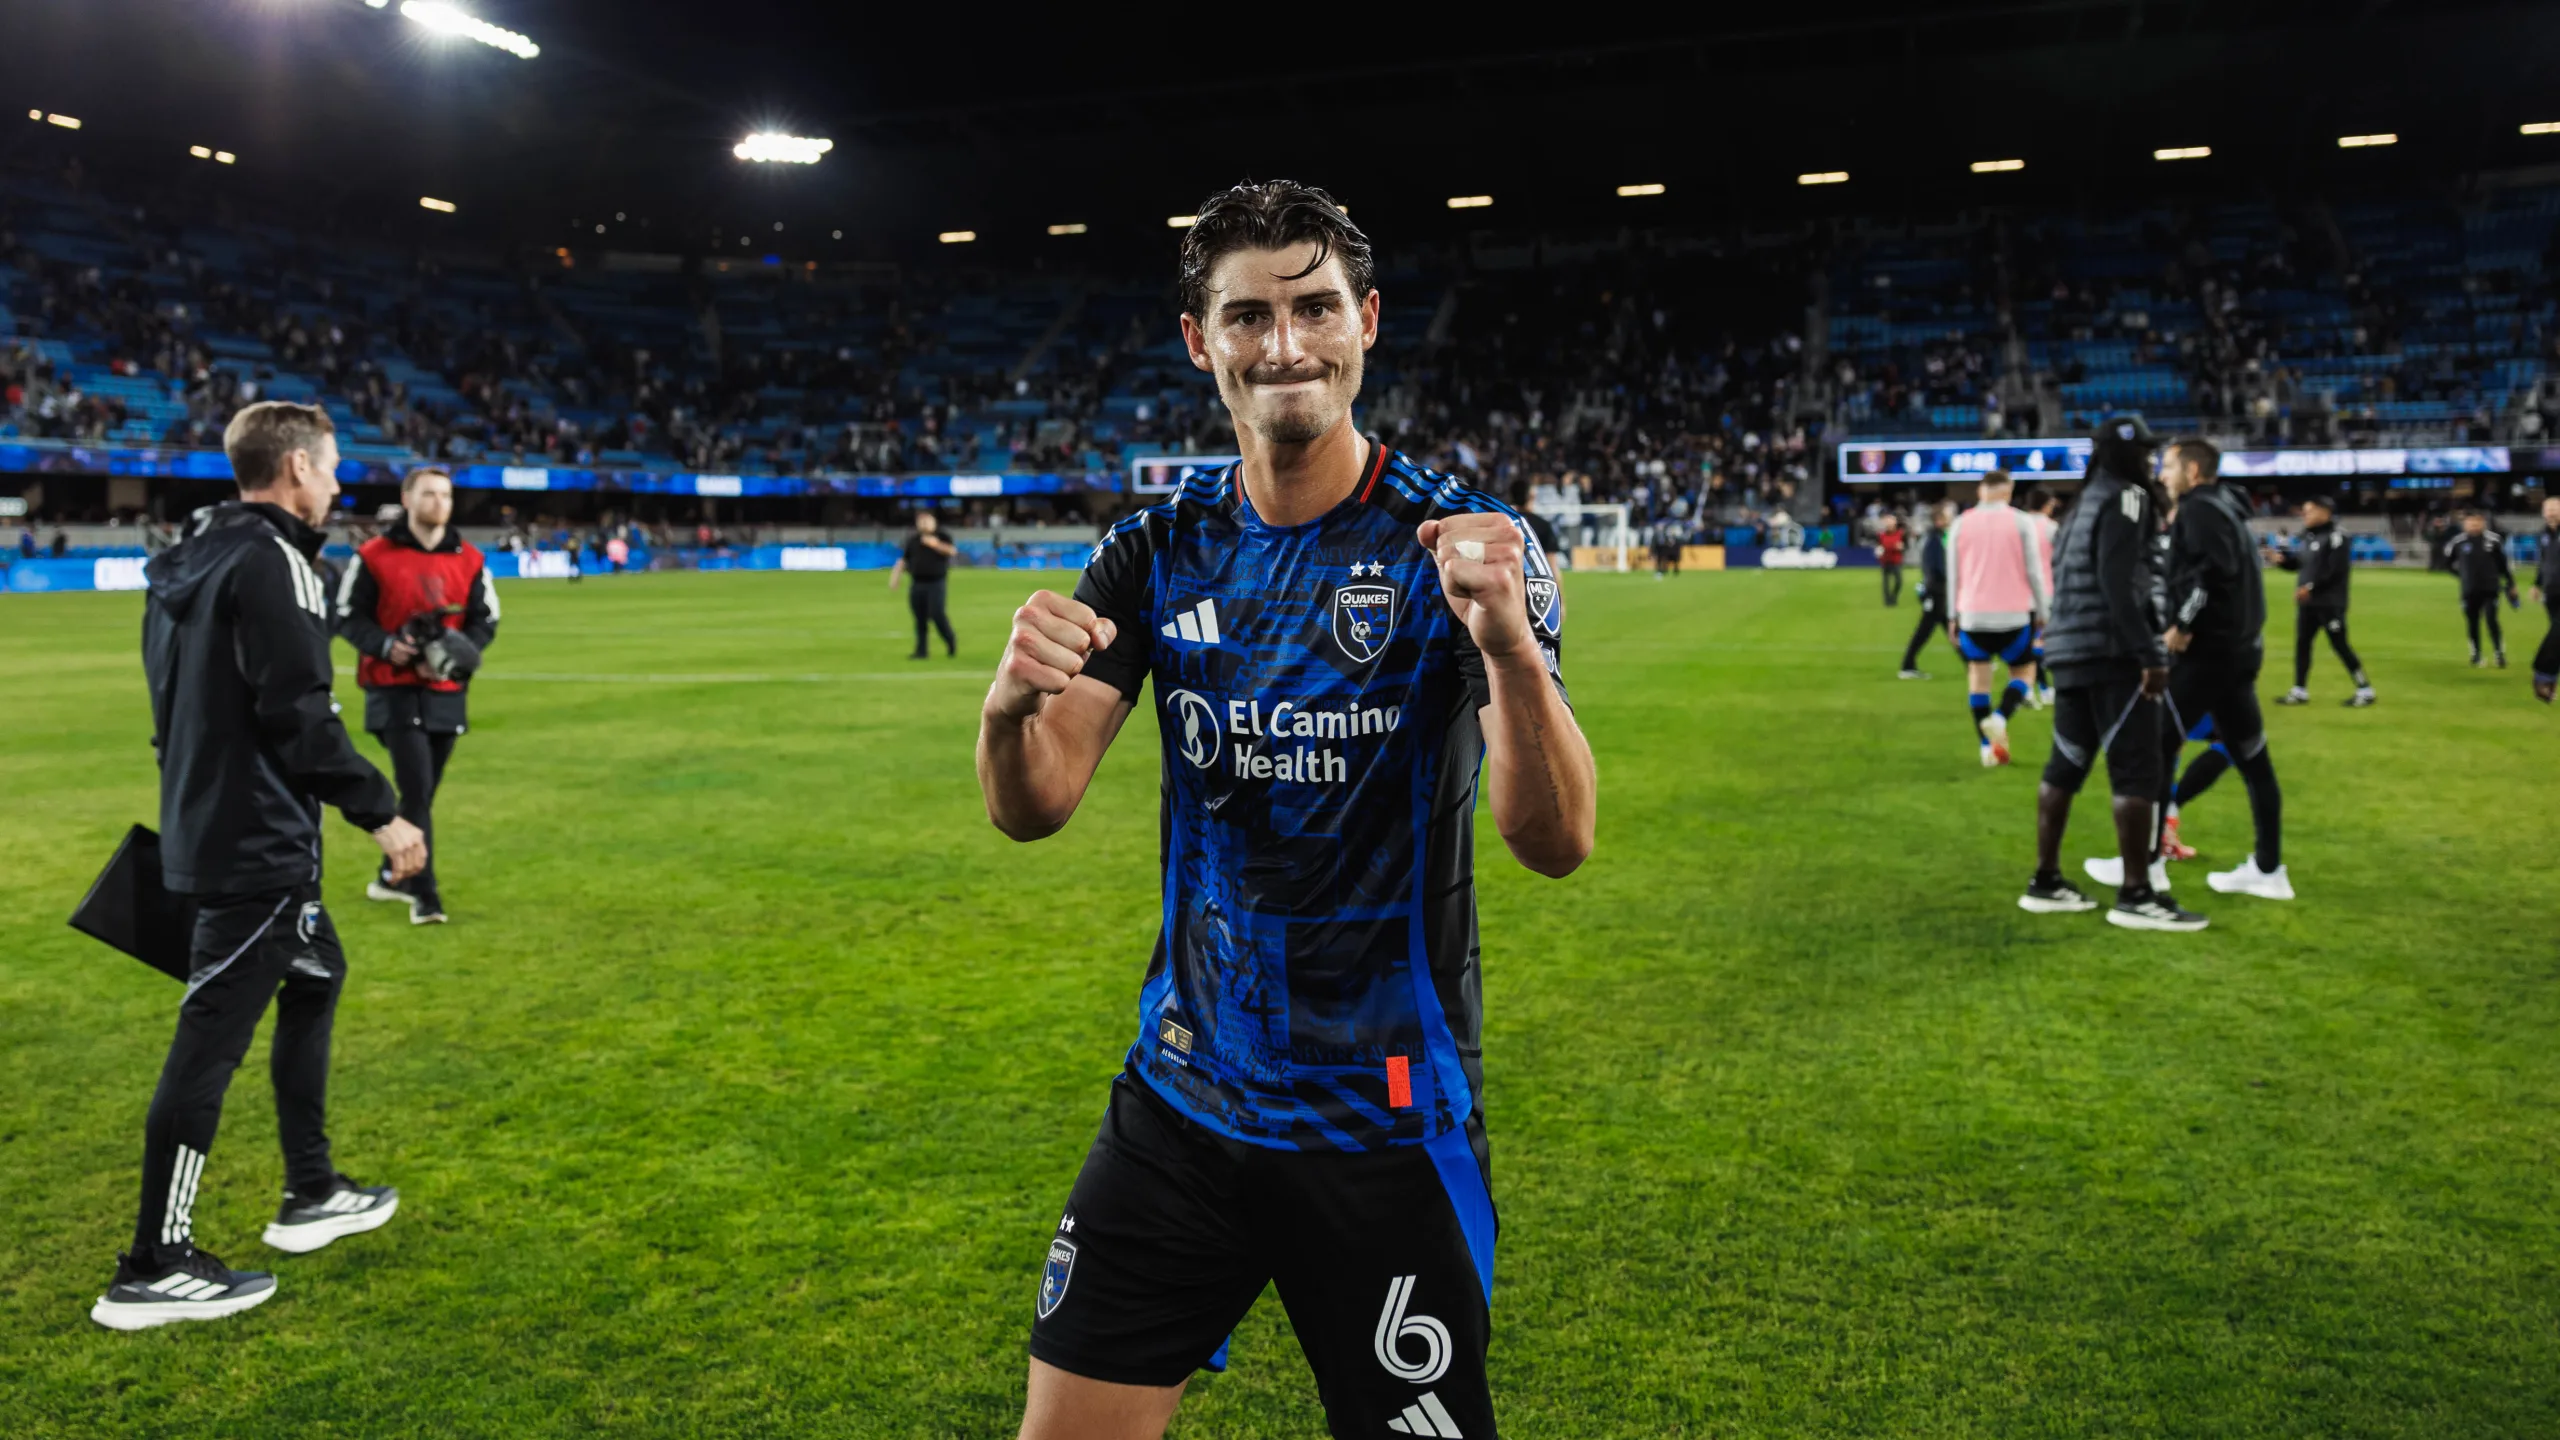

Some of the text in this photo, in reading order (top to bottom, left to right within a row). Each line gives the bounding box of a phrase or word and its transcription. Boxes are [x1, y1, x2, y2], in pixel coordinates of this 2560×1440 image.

[1340, 592, 1389, 605] QUAKES
[1530, 583, 1552, 594] MLS
[1228, 700, 1263, 736] El
[1270, 697, 1400, 739] Camino
[1234, 743, 1346, 783] Health
[1374, 1275, 1453, 1384] 6
